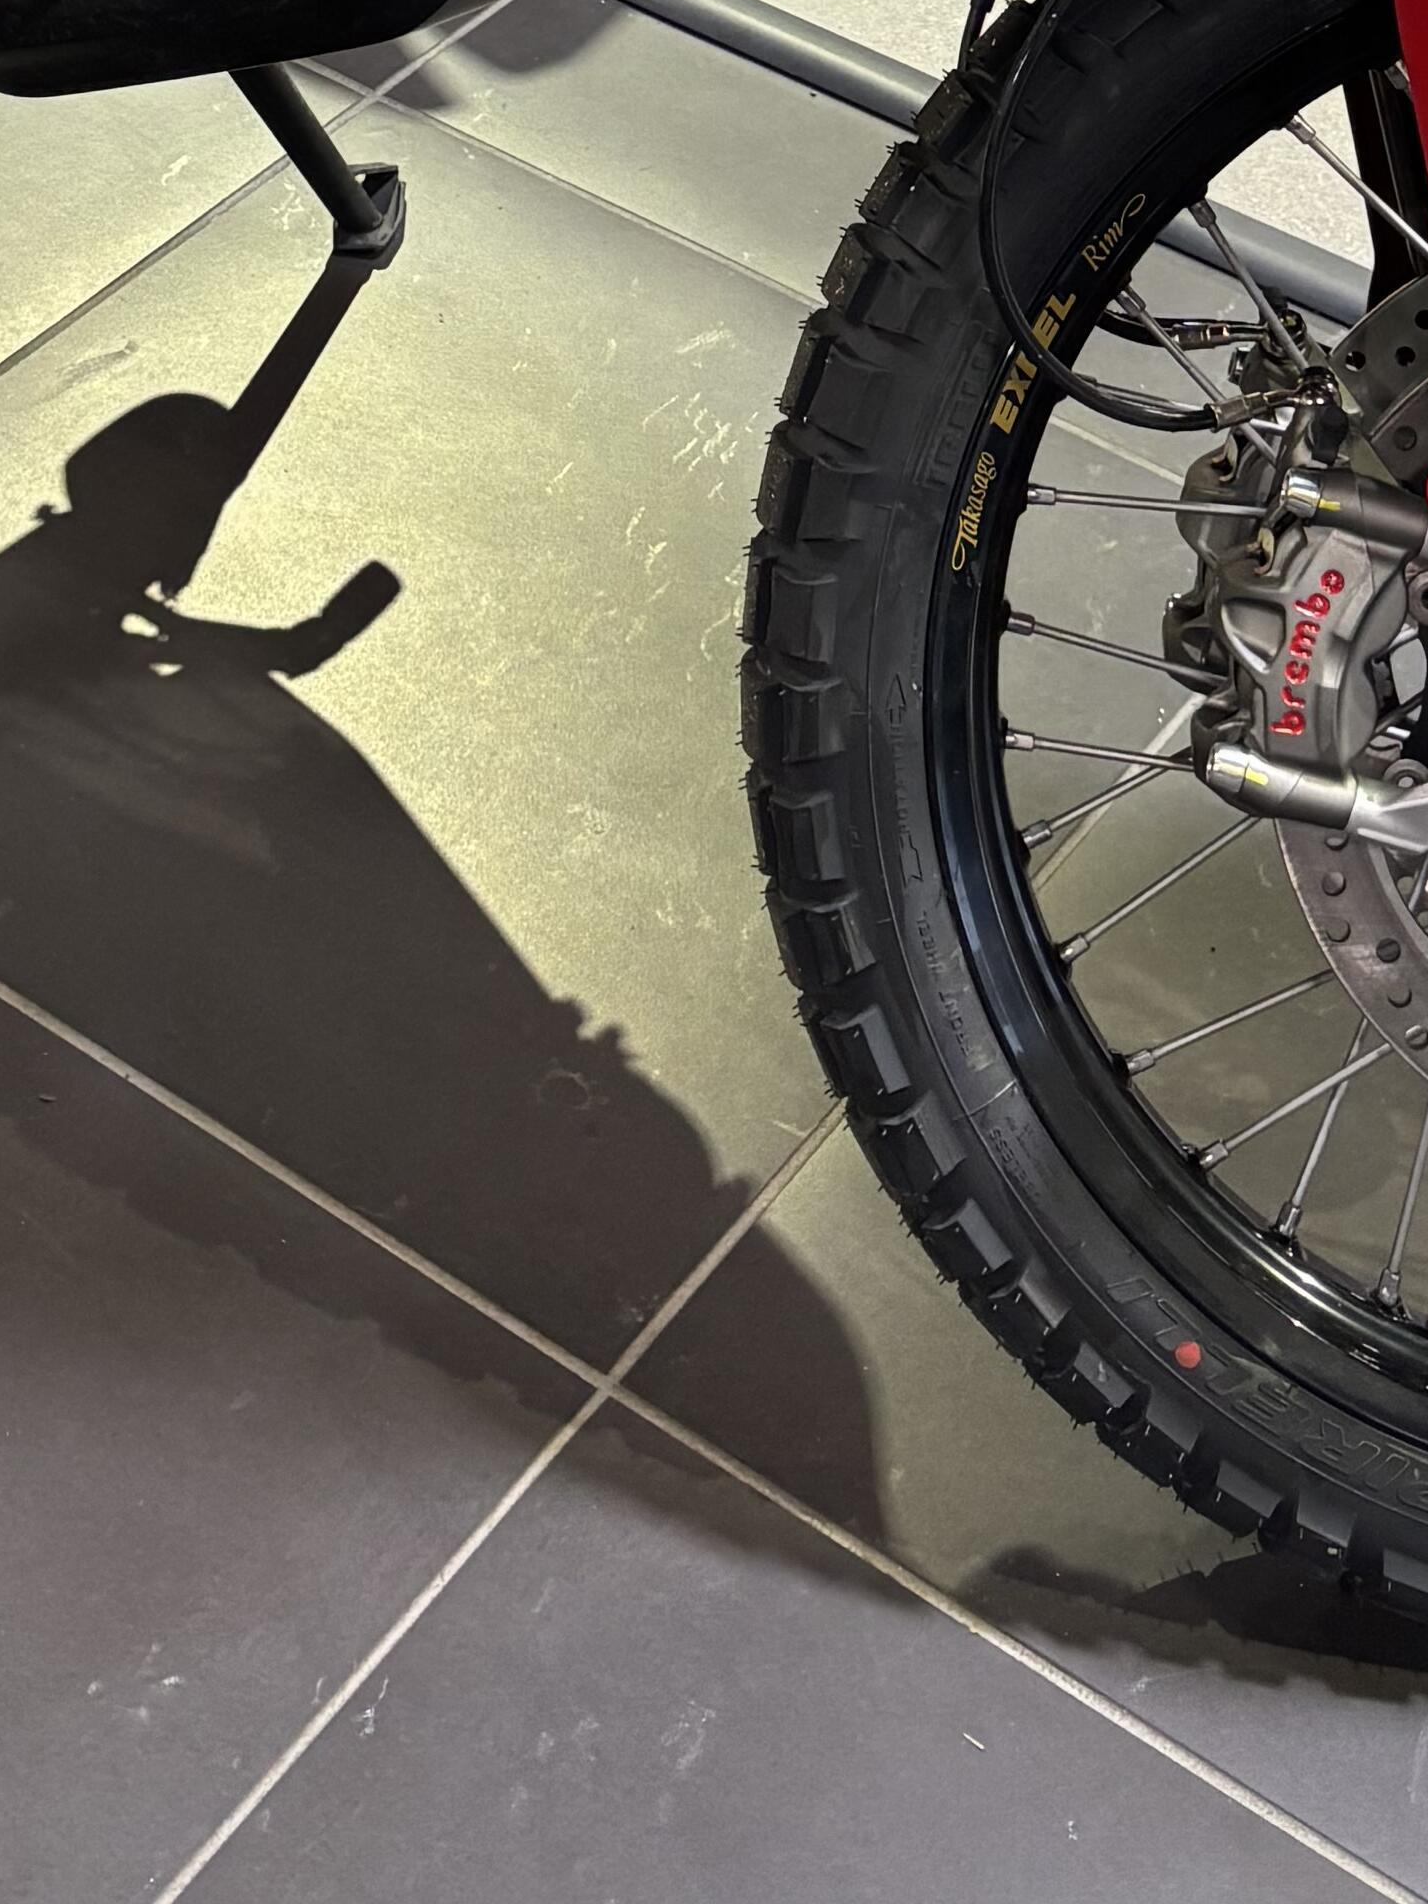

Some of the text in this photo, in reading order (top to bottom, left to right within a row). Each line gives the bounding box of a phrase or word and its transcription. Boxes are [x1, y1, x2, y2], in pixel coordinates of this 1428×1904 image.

[951, 193, 1146, 572] Takasago EXEL Rim
[1269, 569, 1345, 736] brembo
